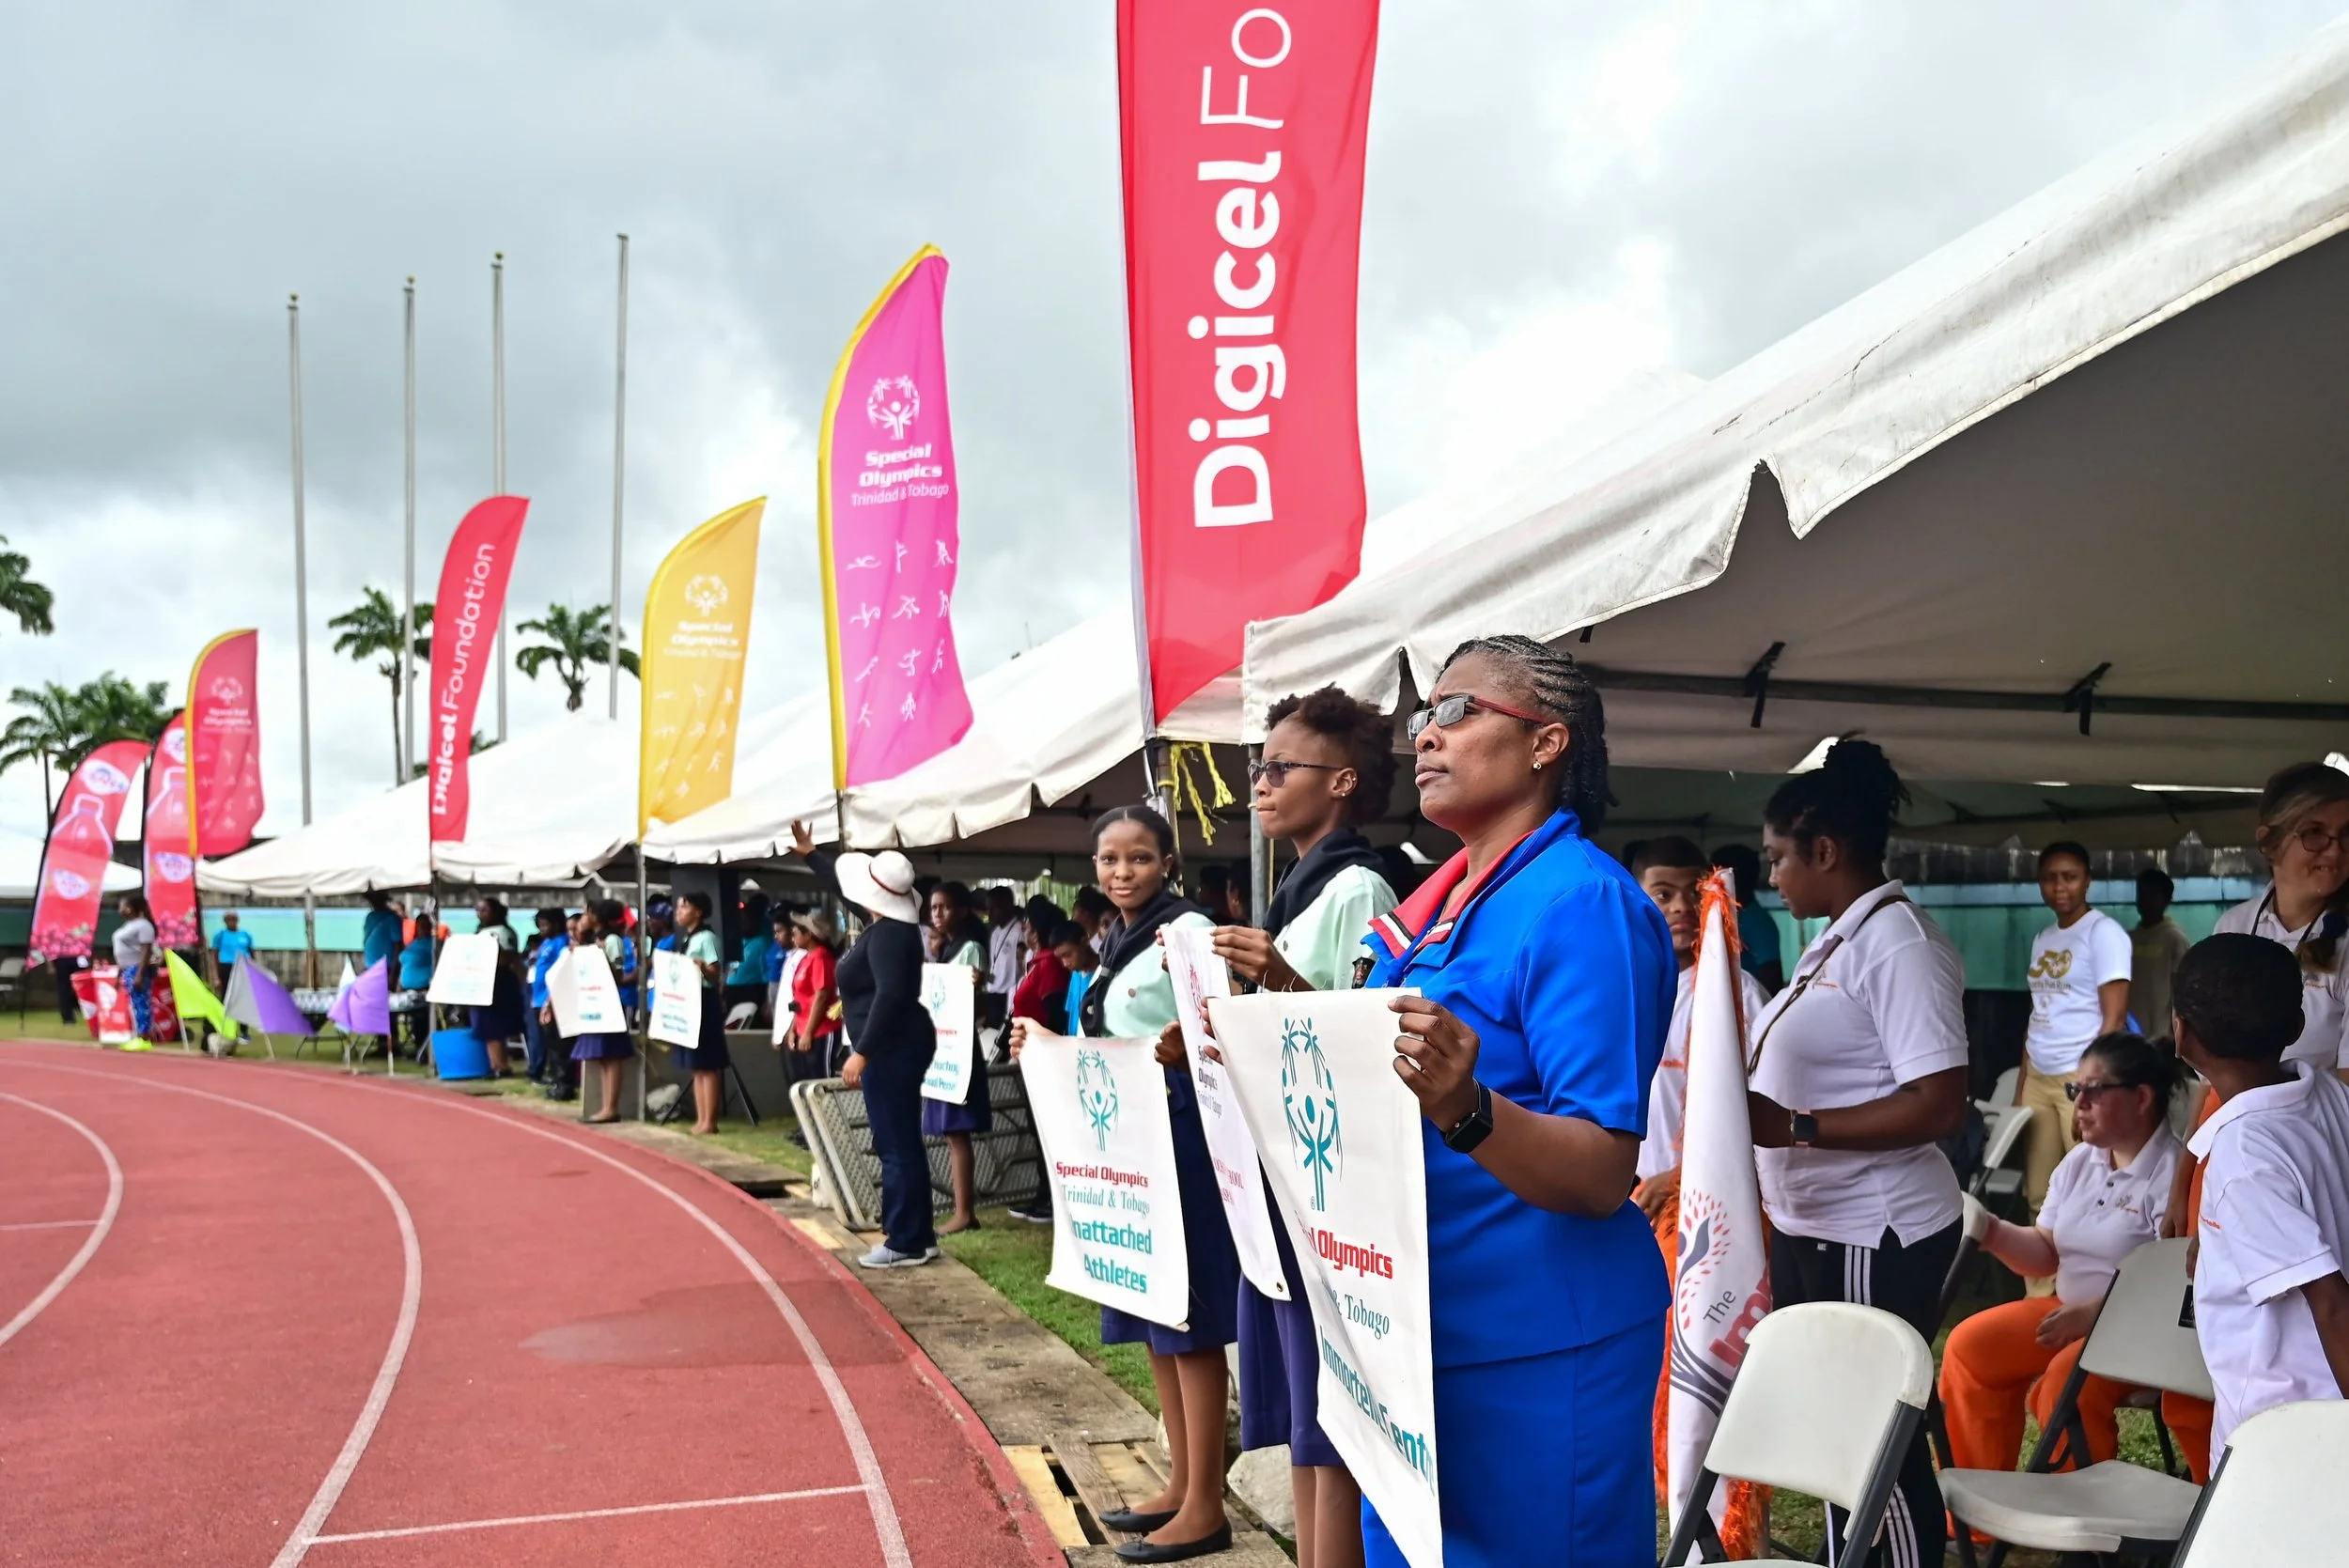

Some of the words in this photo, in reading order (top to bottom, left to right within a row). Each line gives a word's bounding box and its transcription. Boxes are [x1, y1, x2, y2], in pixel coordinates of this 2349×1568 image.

[1187, 150, 1286, 527] Digicel
[865, 442, 933, 468] Special
[859, 462, 943, 488] Olympics
[851, 488, 899, 507] Trinidad
[908, 482, 949, 499] Tobago
[442, 542, 497, 710] Foundation
[1056, 1161, 1098, 1179] Special
[1100, 1166, 1148, 1188] Olympics
[1062, 1184, 1104, 1206] Trinidad
[1108, 1189, 1116, 1208] &
[1121, 1190, 1150, 1219] Tobago
[1317, 1229, 1392, 1280] Olympics
[1083, 1253, 1147, 1294] Athletes
[1345, 1294, 1390, 1340] Tobago
[1703, 1290, 1736, 1324] The
